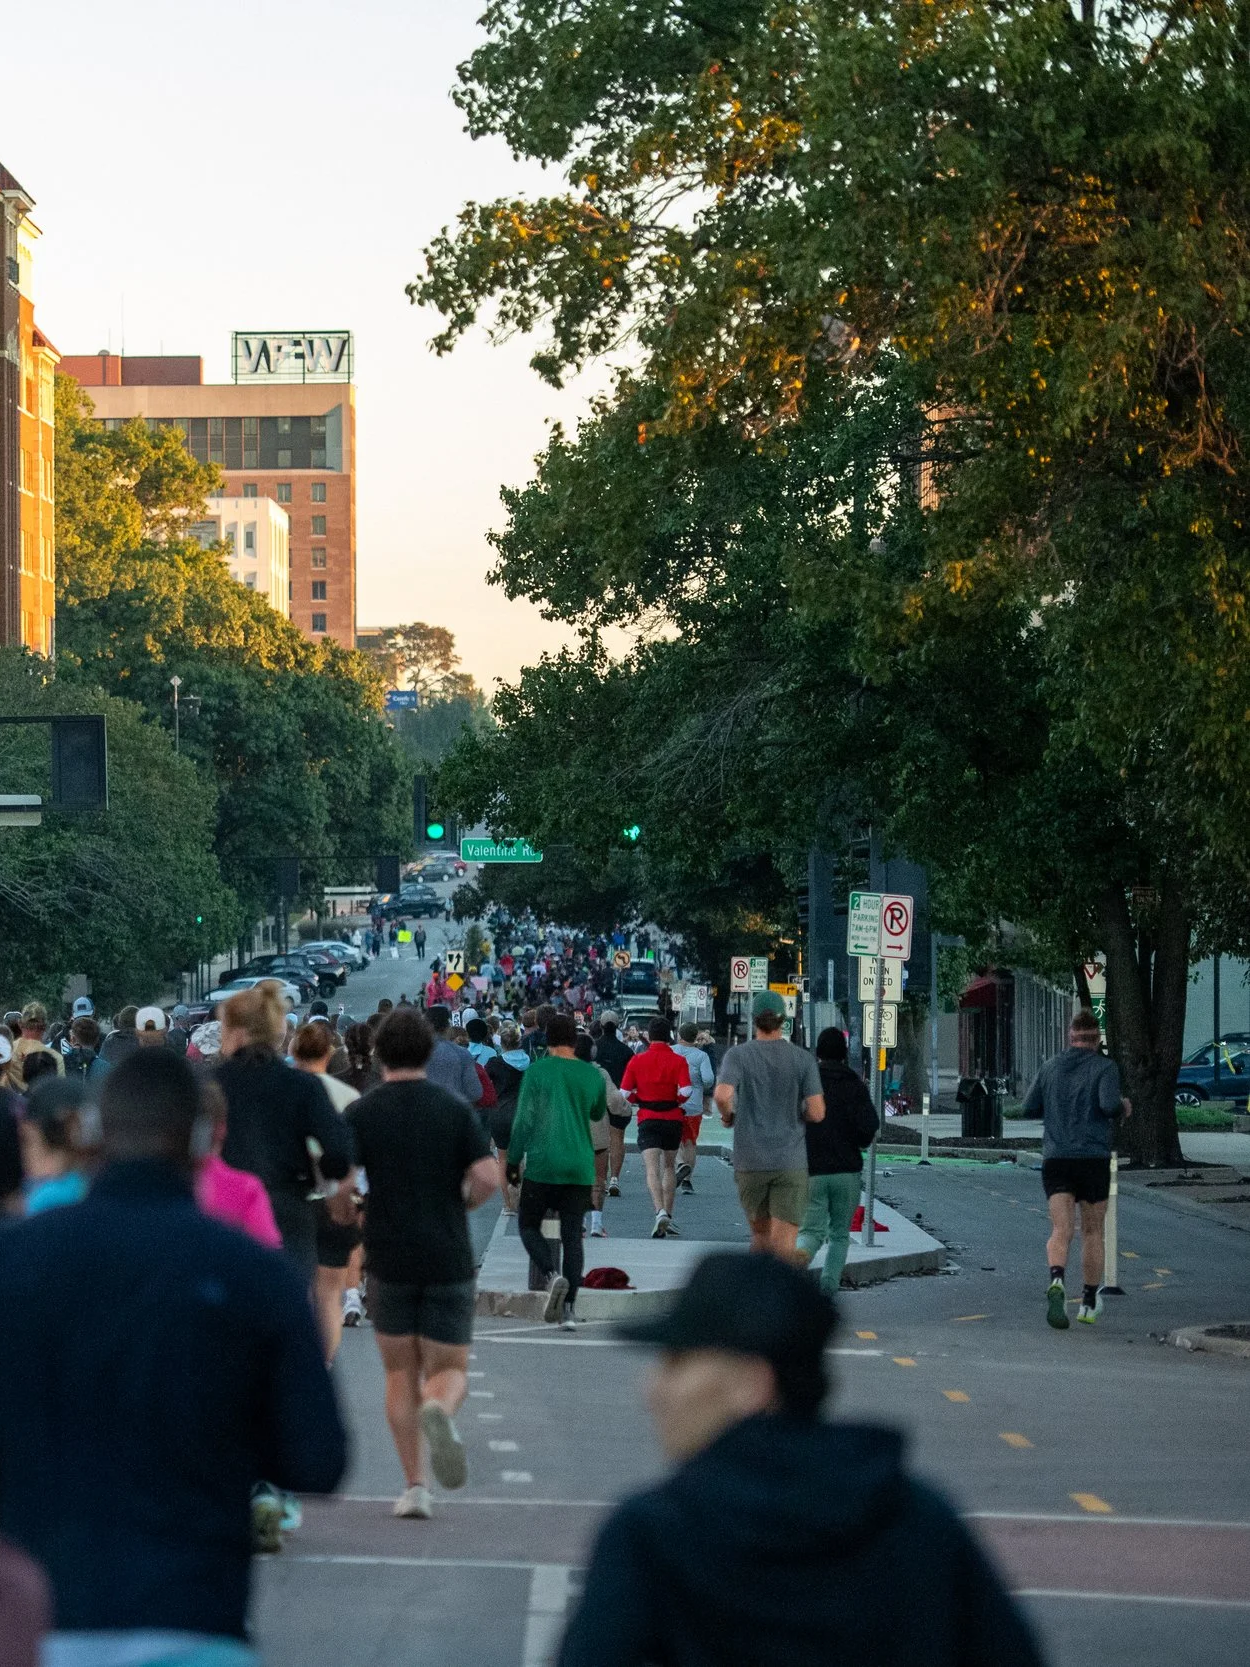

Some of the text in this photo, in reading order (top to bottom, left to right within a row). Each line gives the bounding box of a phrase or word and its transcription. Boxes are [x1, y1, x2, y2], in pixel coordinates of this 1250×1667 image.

[238, 337, 348, 373] VFW
[467, 844, 517, 856] Valentine
[854, 896, 860, 910] 2
[853, 913, 879, 923] PARKING
[869, 967, 890, 976] TUN
[863, 977, 874, 986] ON
